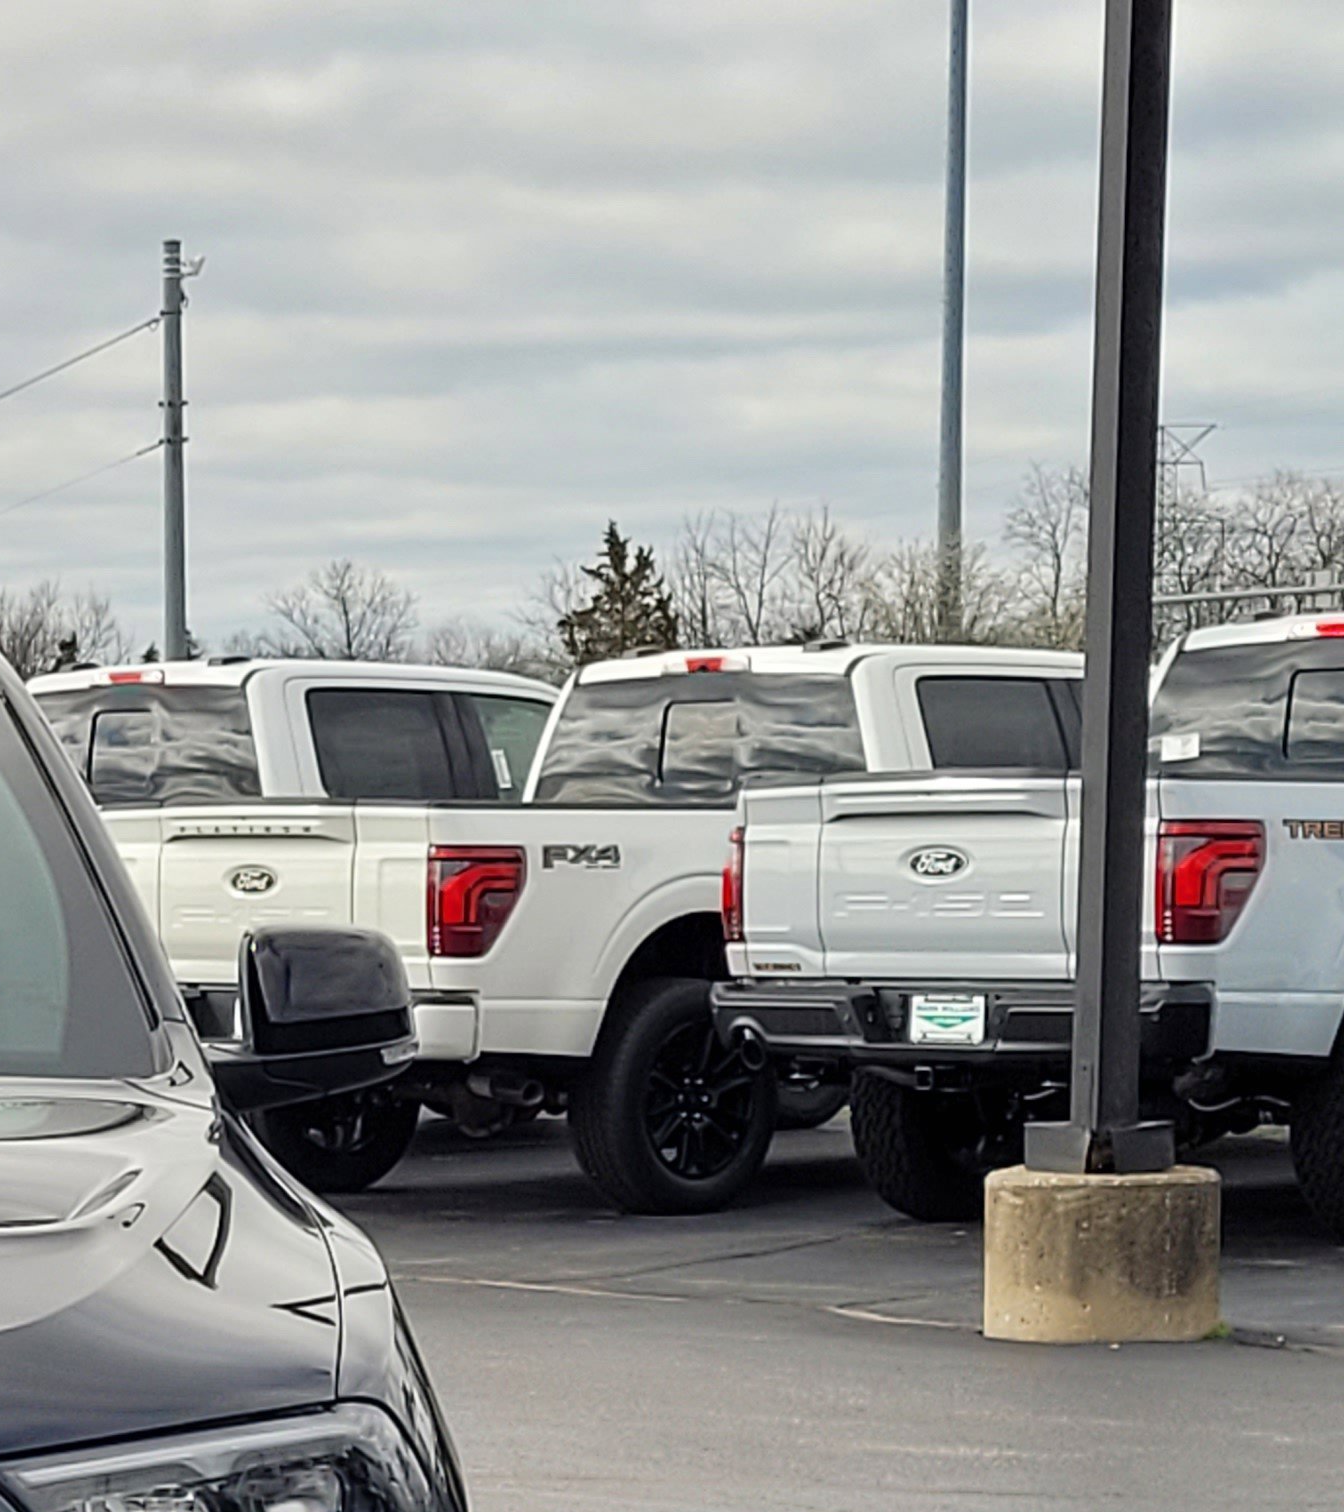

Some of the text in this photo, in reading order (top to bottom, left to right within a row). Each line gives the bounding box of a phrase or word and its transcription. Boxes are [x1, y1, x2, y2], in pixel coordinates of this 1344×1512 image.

[1282, 818, 1344, 840] TRE
[541, 844, 621, 869] FX4
[914, 851, 960, 875] Ford
